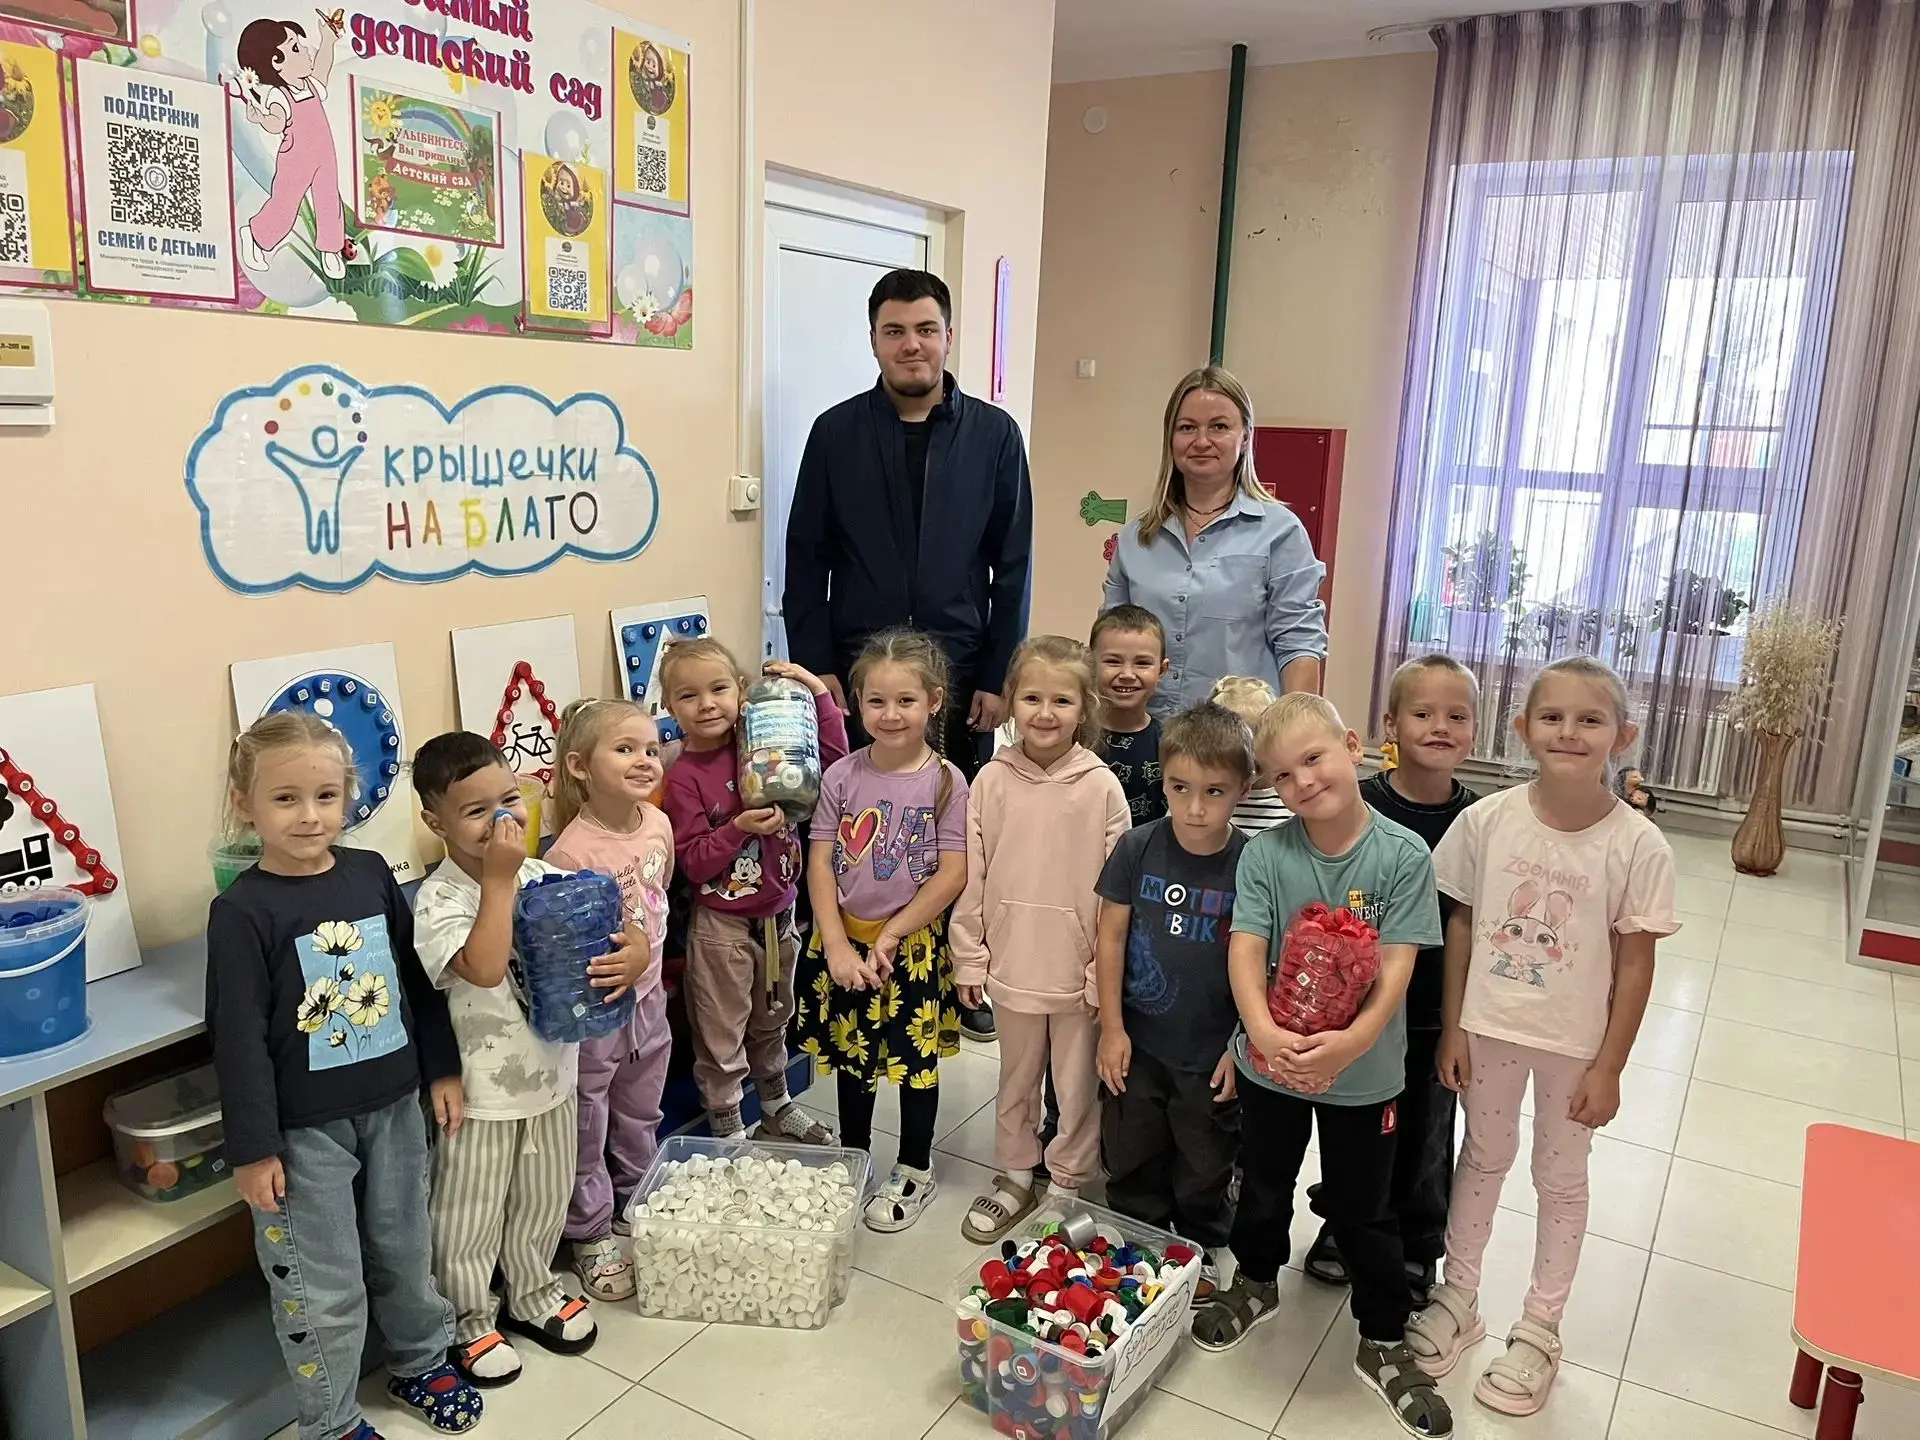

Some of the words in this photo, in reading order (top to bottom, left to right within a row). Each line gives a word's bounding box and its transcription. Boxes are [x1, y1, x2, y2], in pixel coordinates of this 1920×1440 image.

[350, 13, 535, 94] детский
[549, 72, 602, 121] сад
[127, 82, 174, 106] МЕРЫ
[104, 96, 199, 129] ПОДДЕРЖКИ
[398, 143, 414, 156] Вы
[451, 175, 472, 187] сад
[97, 230, 145, 251] СЕМЕЙ
[148, 236, 158, 252] С
[161, 238, 216, 260] ДЕТЬМИ
[387, 499, 443, 551] НА
[459, 491, 599, 548] БЛАГО
